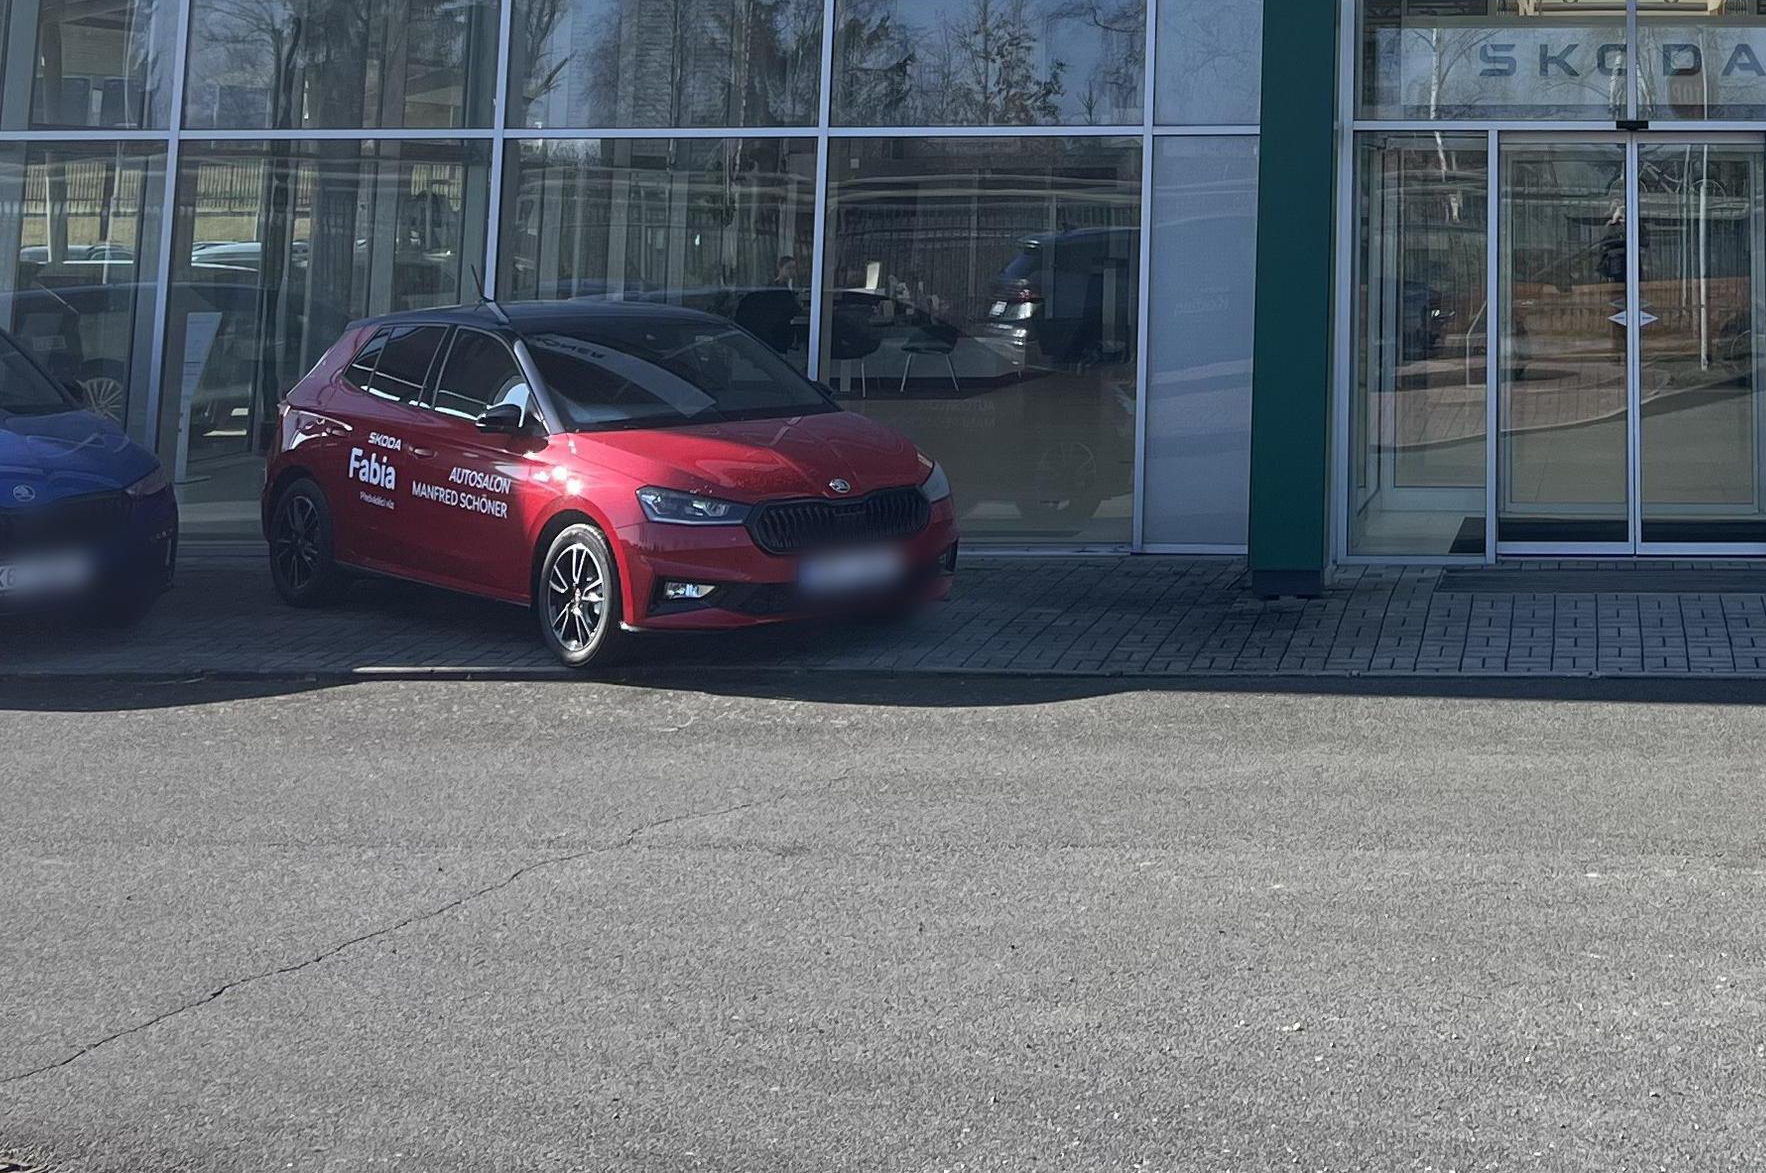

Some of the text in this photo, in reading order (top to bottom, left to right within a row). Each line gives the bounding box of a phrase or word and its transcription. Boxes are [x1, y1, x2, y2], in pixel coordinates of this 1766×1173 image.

[348, 446, 397, 491] Fabia
[448, 466, 513, 495] AUTOSALON
[411, 480, 509, 519] MANFRED SCHÖNER
